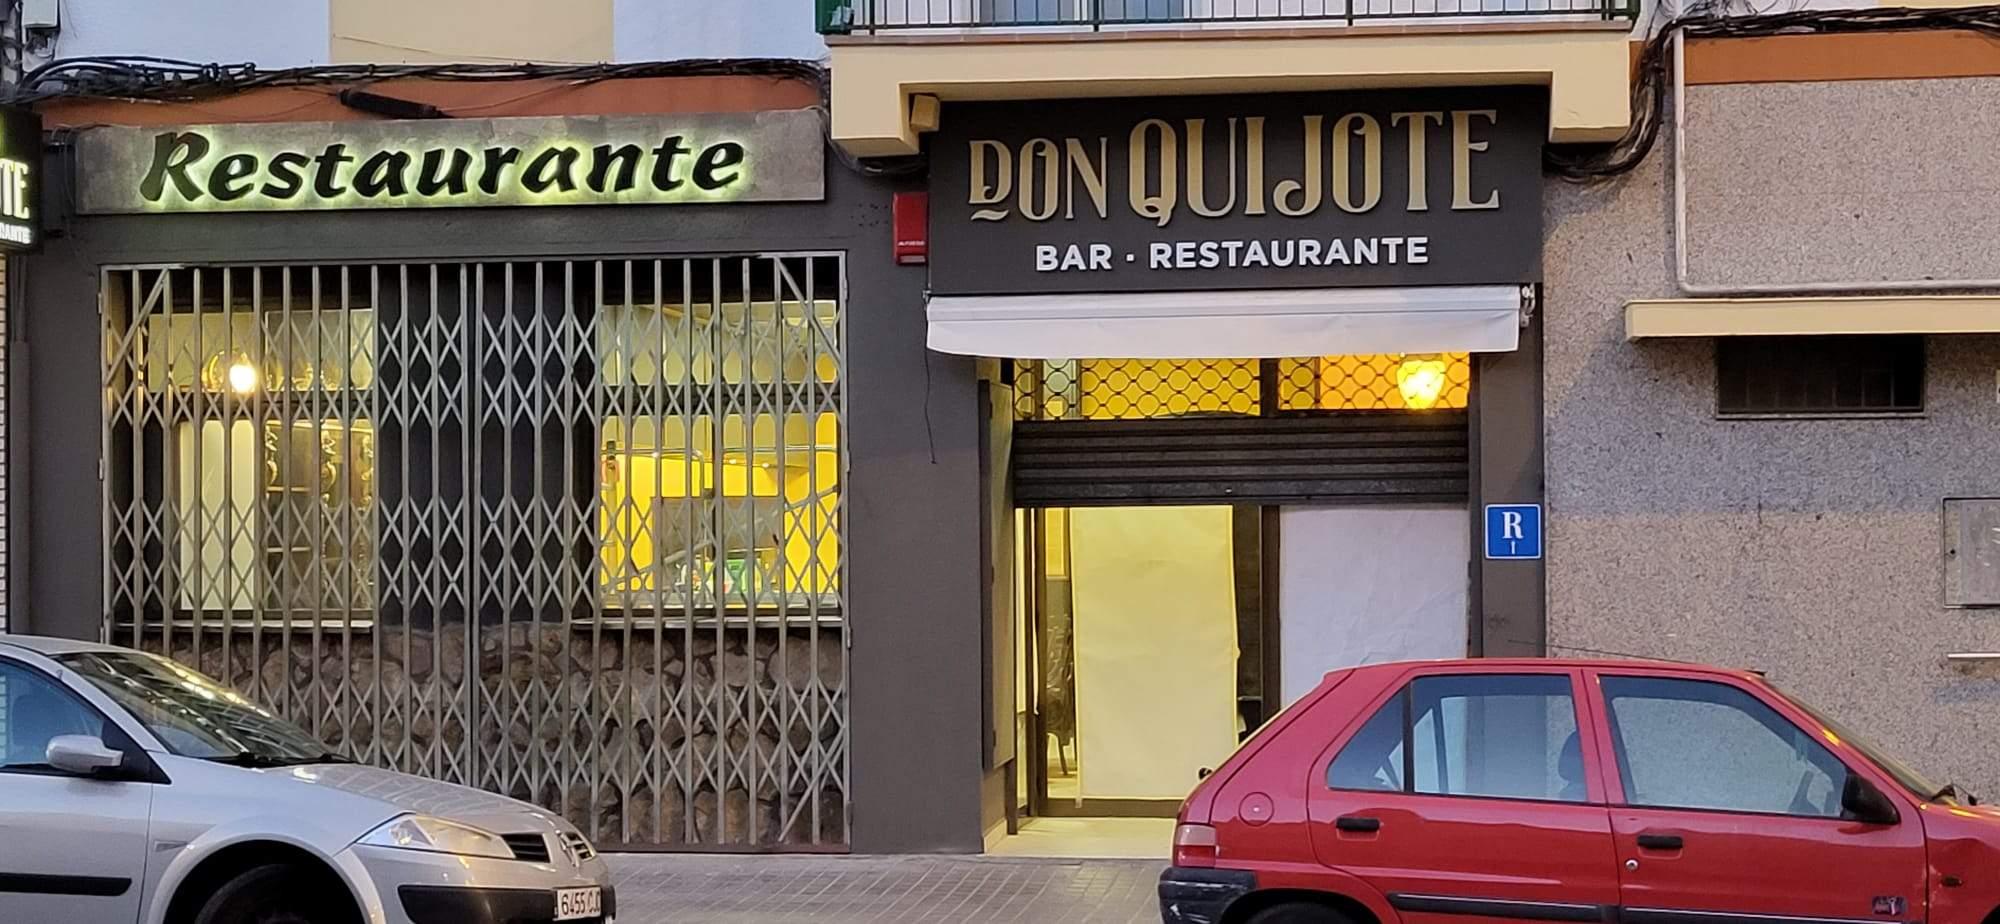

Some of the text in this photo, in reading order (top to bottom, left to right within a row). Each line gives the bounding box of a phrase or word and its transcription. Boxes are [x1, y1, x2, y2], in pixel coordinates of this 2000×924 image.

[0, 157, 30, 219] TE
[139, 131, 746, 202] Restaurante
[968, 109, 1500, 227] DON QUIJOTE
[1035, 244, 1113, 271] BAR
[1149, 236, 1429, 269] RESTAURANTE
[1501, 511, 1524, 539] R
